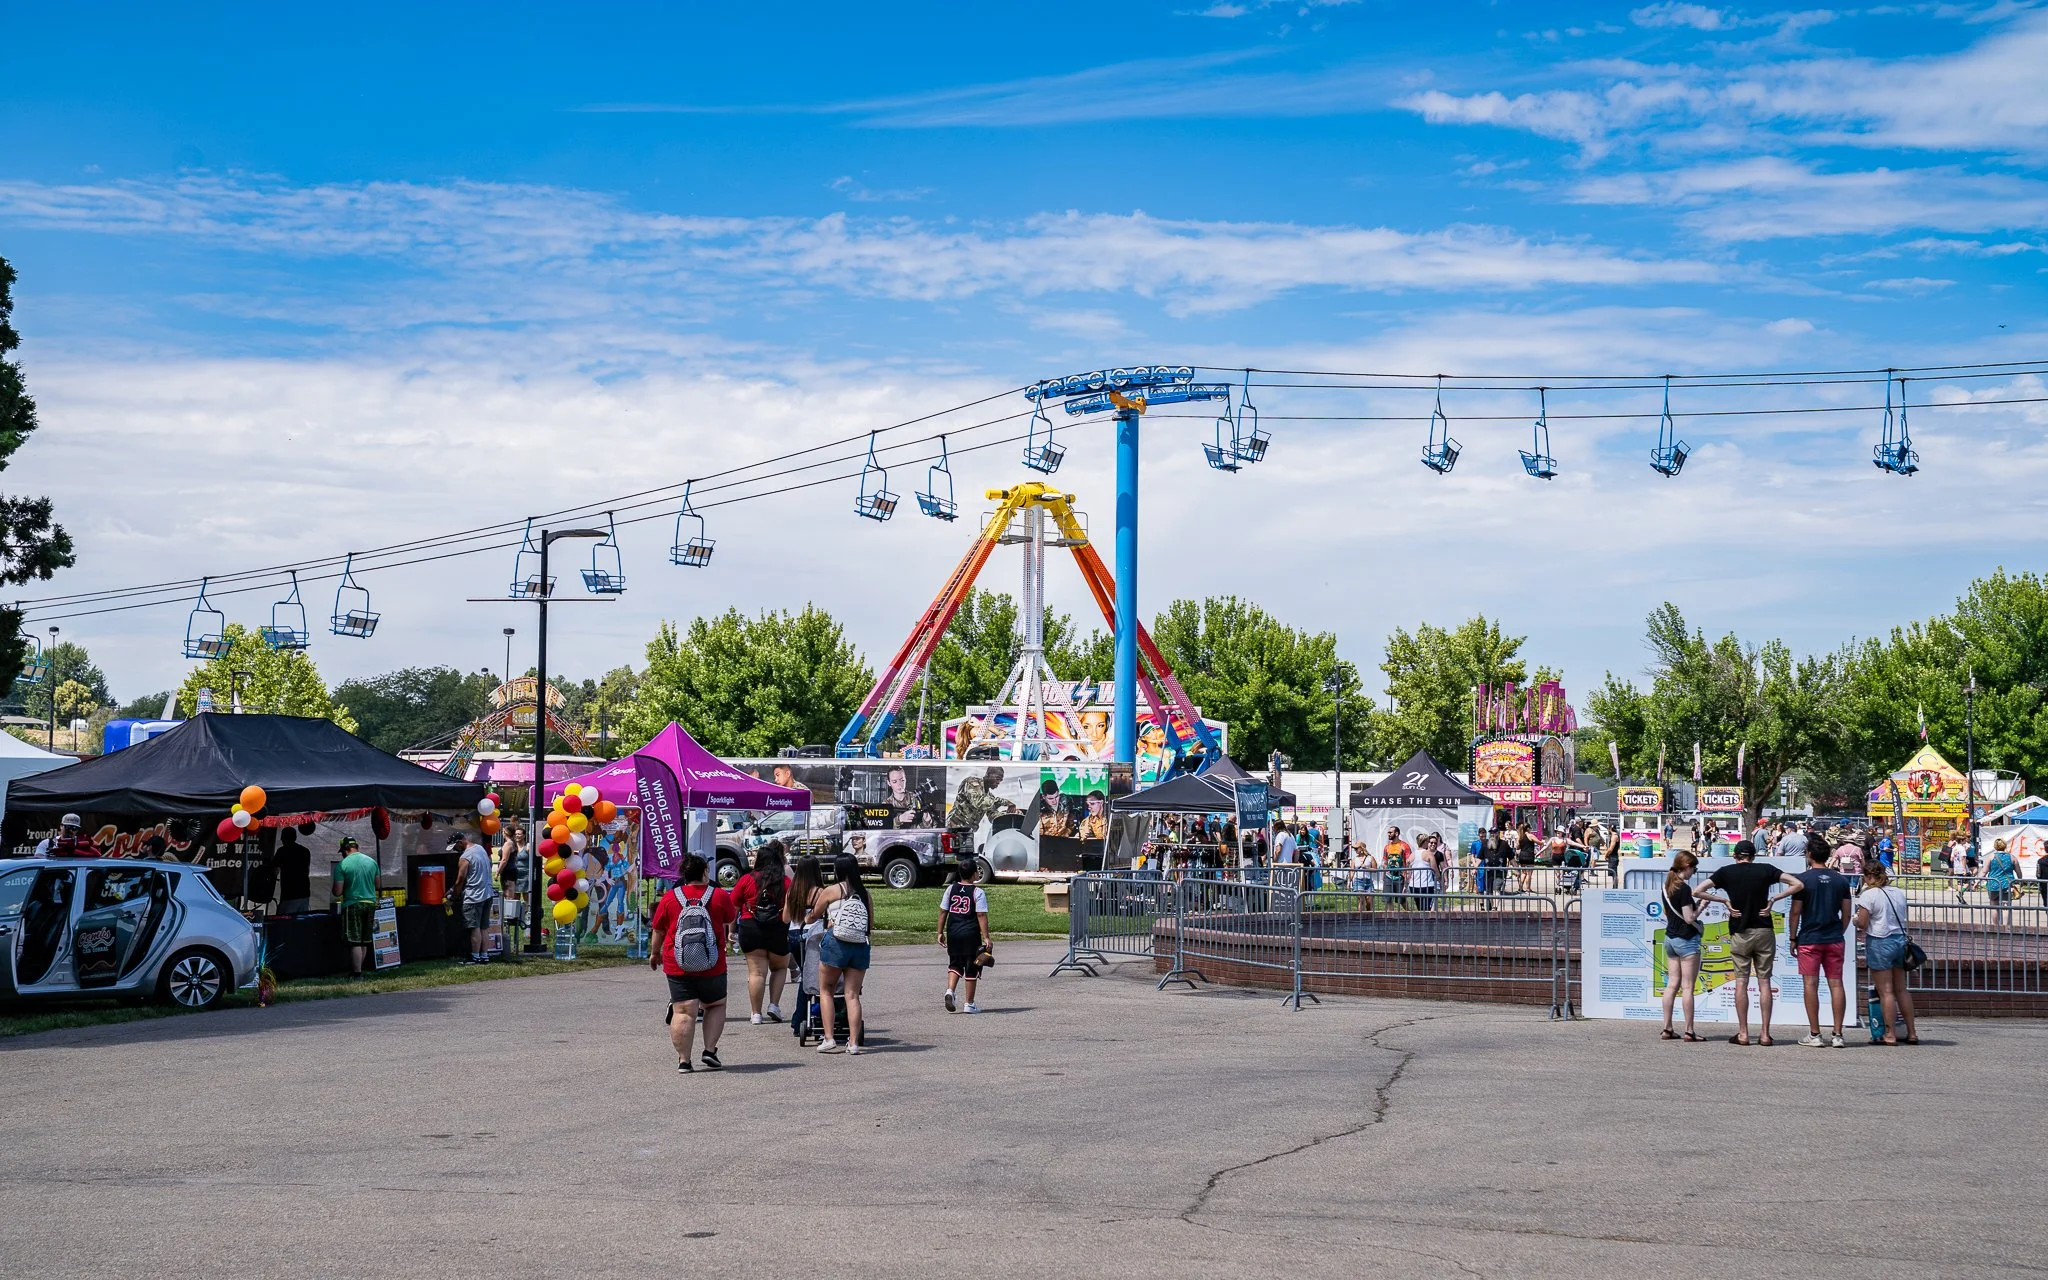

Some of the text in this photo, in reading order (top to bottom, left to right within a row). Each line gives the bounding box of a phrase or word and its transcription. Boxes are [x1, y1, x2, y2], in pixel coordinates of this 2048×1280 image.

[1490, 755, 1517, 768] EARS
[1402, 771, 1429, 787] 21
[709, 795, 735, 806] Sparklight
[1364, 797, 1402, 805] CHASE
[1409, 797, 1431, 805] THE
[1503, 791, 1532, 801] CAKES
[1624, 794, 1658, 805] TICKETS
[1703, 794, 1739, 804] TICKETS
[768, 798, 793, 808] Sparklight
[651, 779, 682, 858] WHOLE HOME
[864, 809, 889, 817] ANTED
[637, 777, 670, 868] WIFI COVERAGE
[234, 843, 263, 856] WLL,
[949, 895, 971, 914] 23
